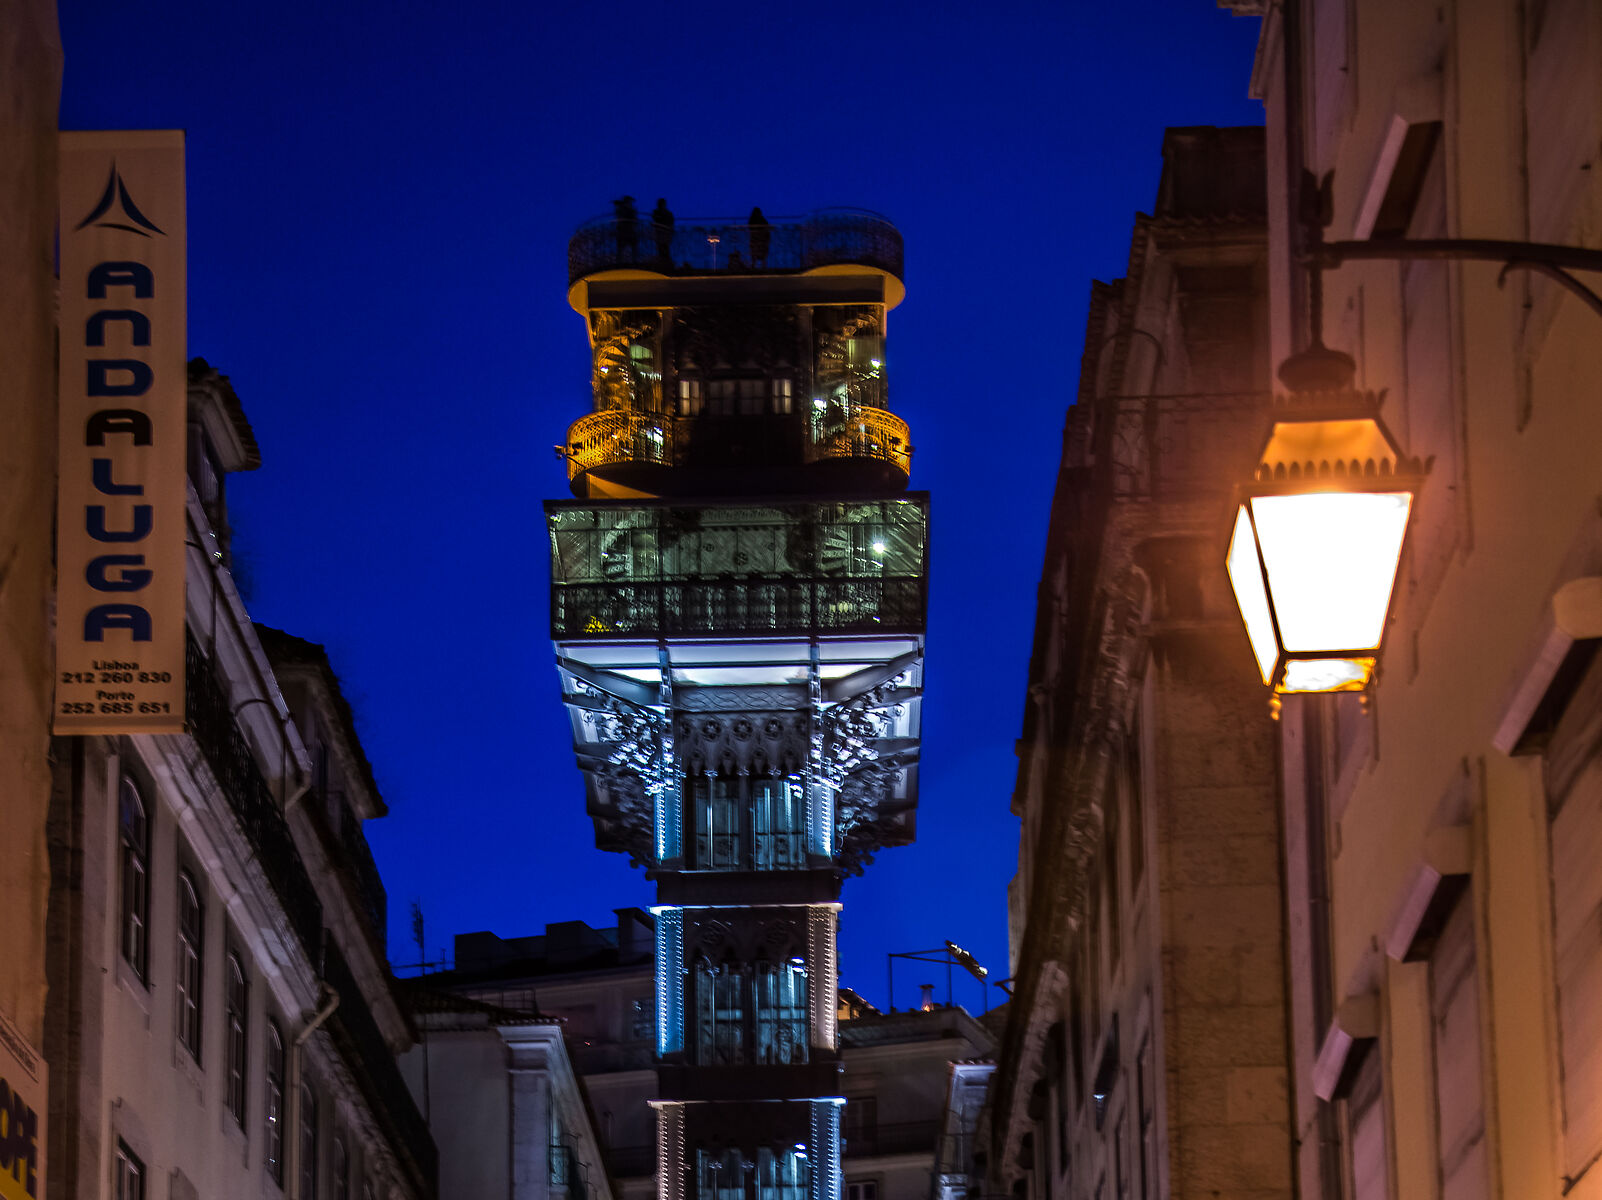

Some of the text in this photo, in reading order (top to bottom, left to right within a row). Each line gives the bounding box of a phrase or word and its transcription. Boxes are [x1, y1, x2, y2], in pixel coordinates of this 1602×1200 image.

[84, 260, 155, 643] ANDALUGA
[93, 660, 139, 670] Lisboa
[62, 672, 94, 683] 212
[96, 690, 134, 700] Porto
[62, 702, 94, 713] 252
